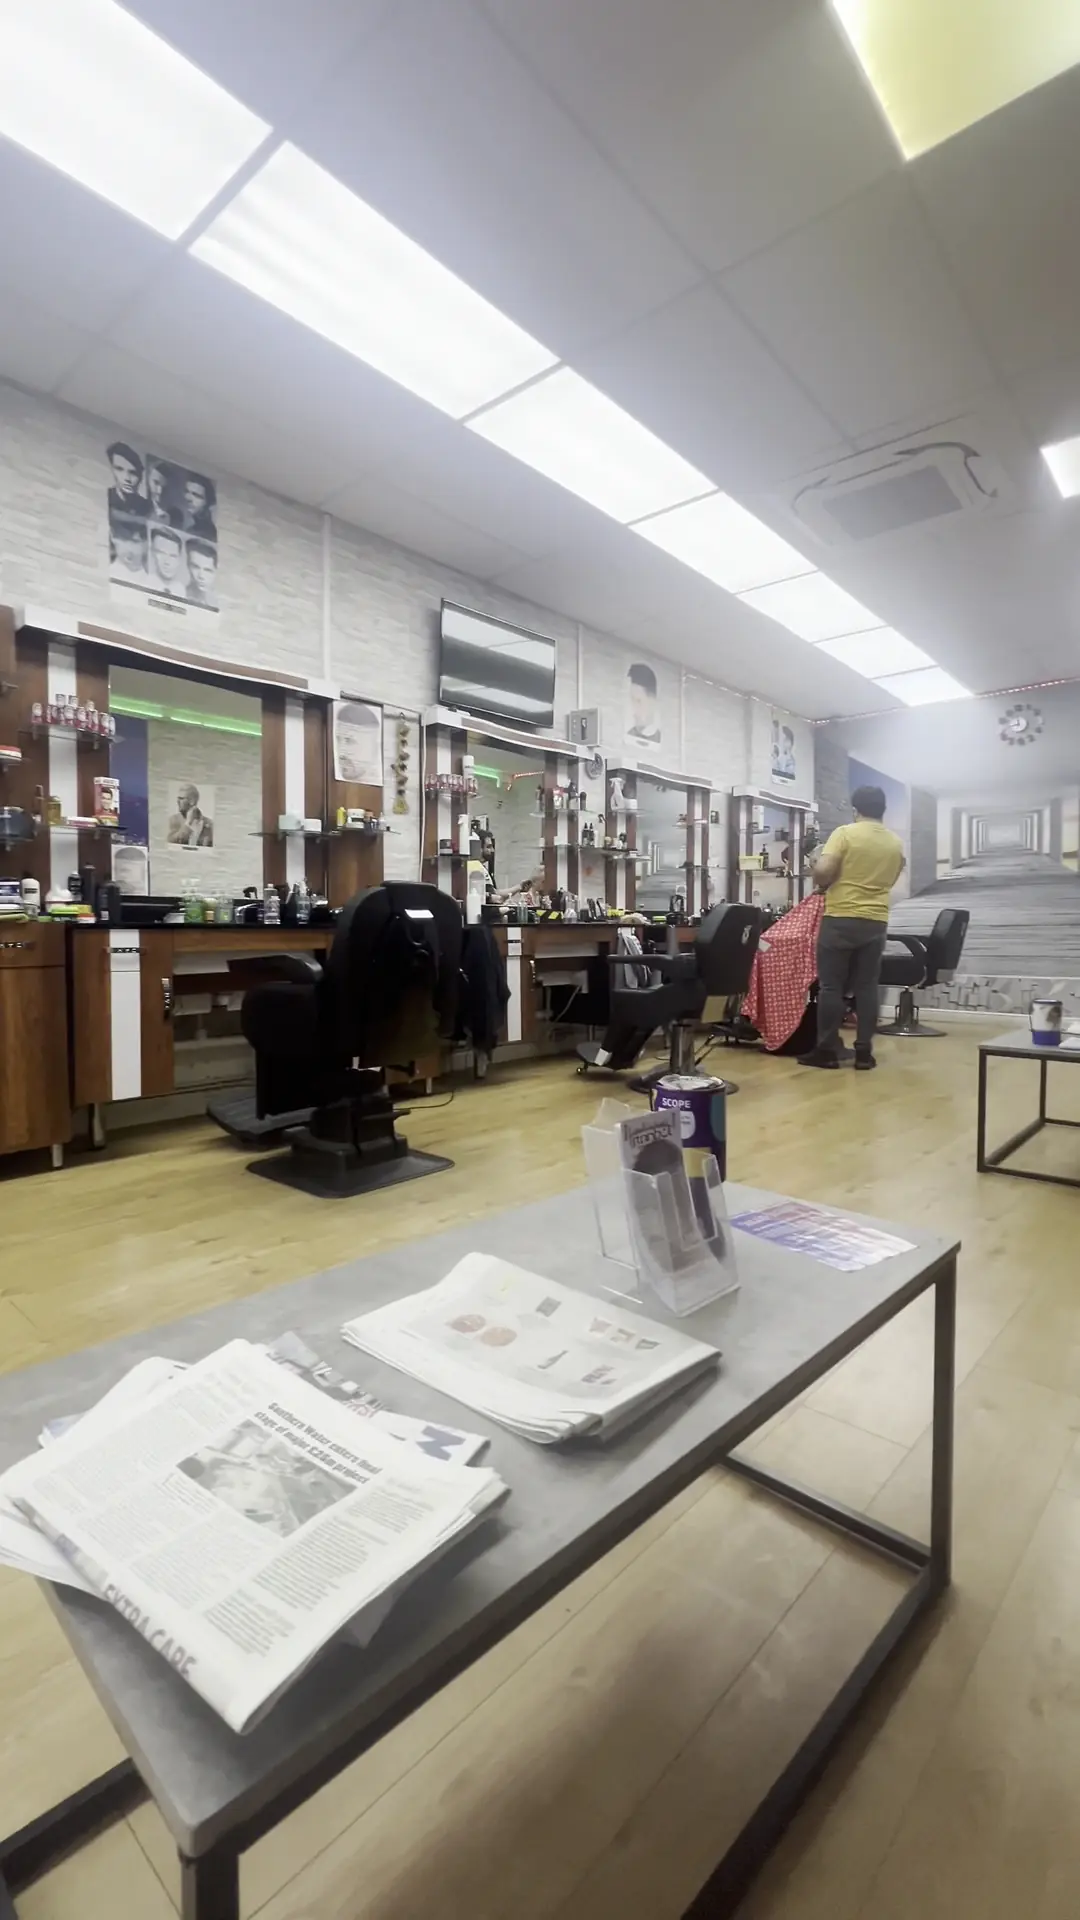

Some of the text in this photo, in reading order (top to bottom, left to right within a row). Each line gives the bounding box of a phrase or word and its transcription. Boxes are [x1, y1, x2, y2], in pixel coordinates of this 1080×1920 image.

[661, 1097, 692, 1109] SCOPE
[254, 1411, 279, 1429] stage
[275, 1425, 290, 1435] of
[332, 1463, 371, 1485] project
[268, 1402, 306, 1430] Southern
[303, 1424, 332, 1445] Water
[328, 1443, 361, 1463] enters
